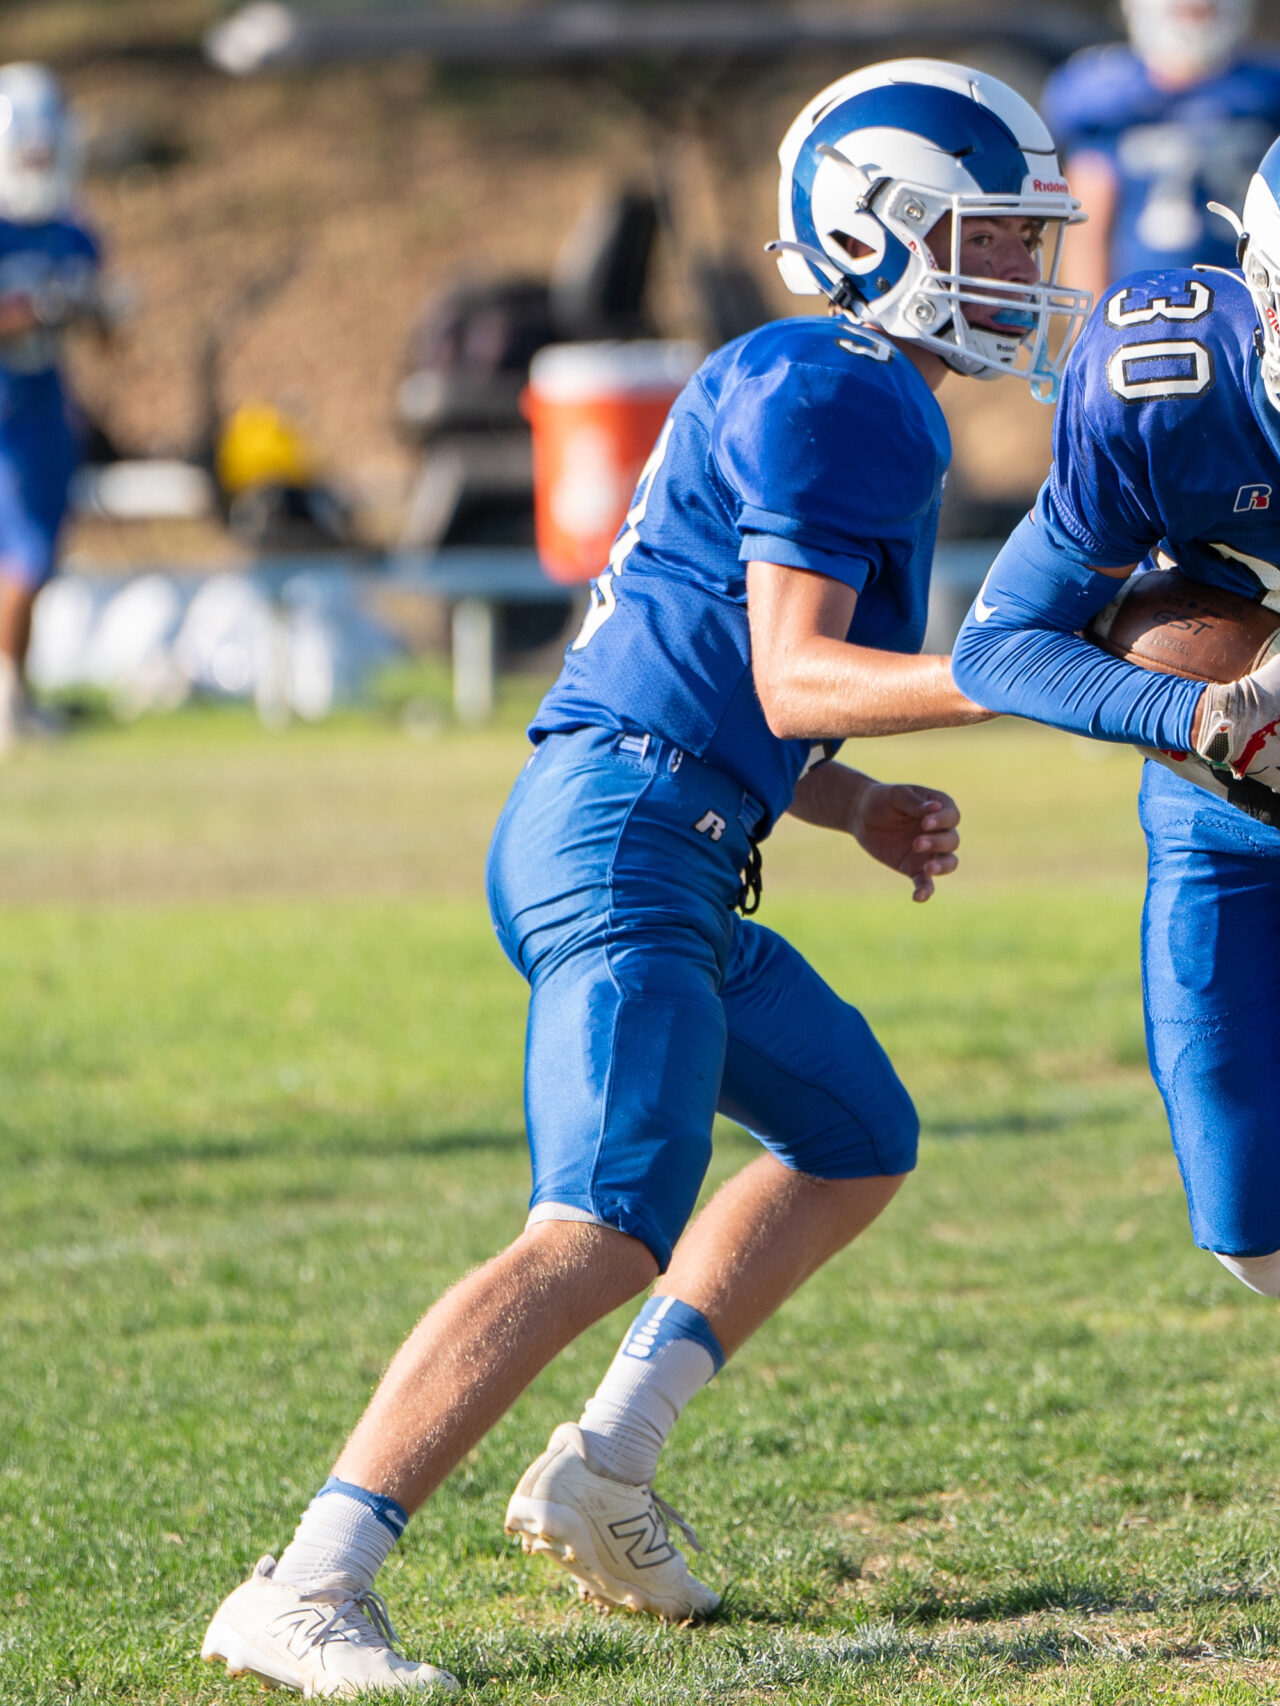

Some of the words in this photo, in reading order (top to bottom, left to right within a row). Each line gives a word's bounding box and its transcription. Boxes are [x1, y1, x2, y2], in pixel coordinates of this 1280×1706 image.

[1104, 280, 1217, 405] 30
[1233, 483, 1273, 513] R
[1153, 609, 1214, 636] GST
[694, 808, 727, 842] R
